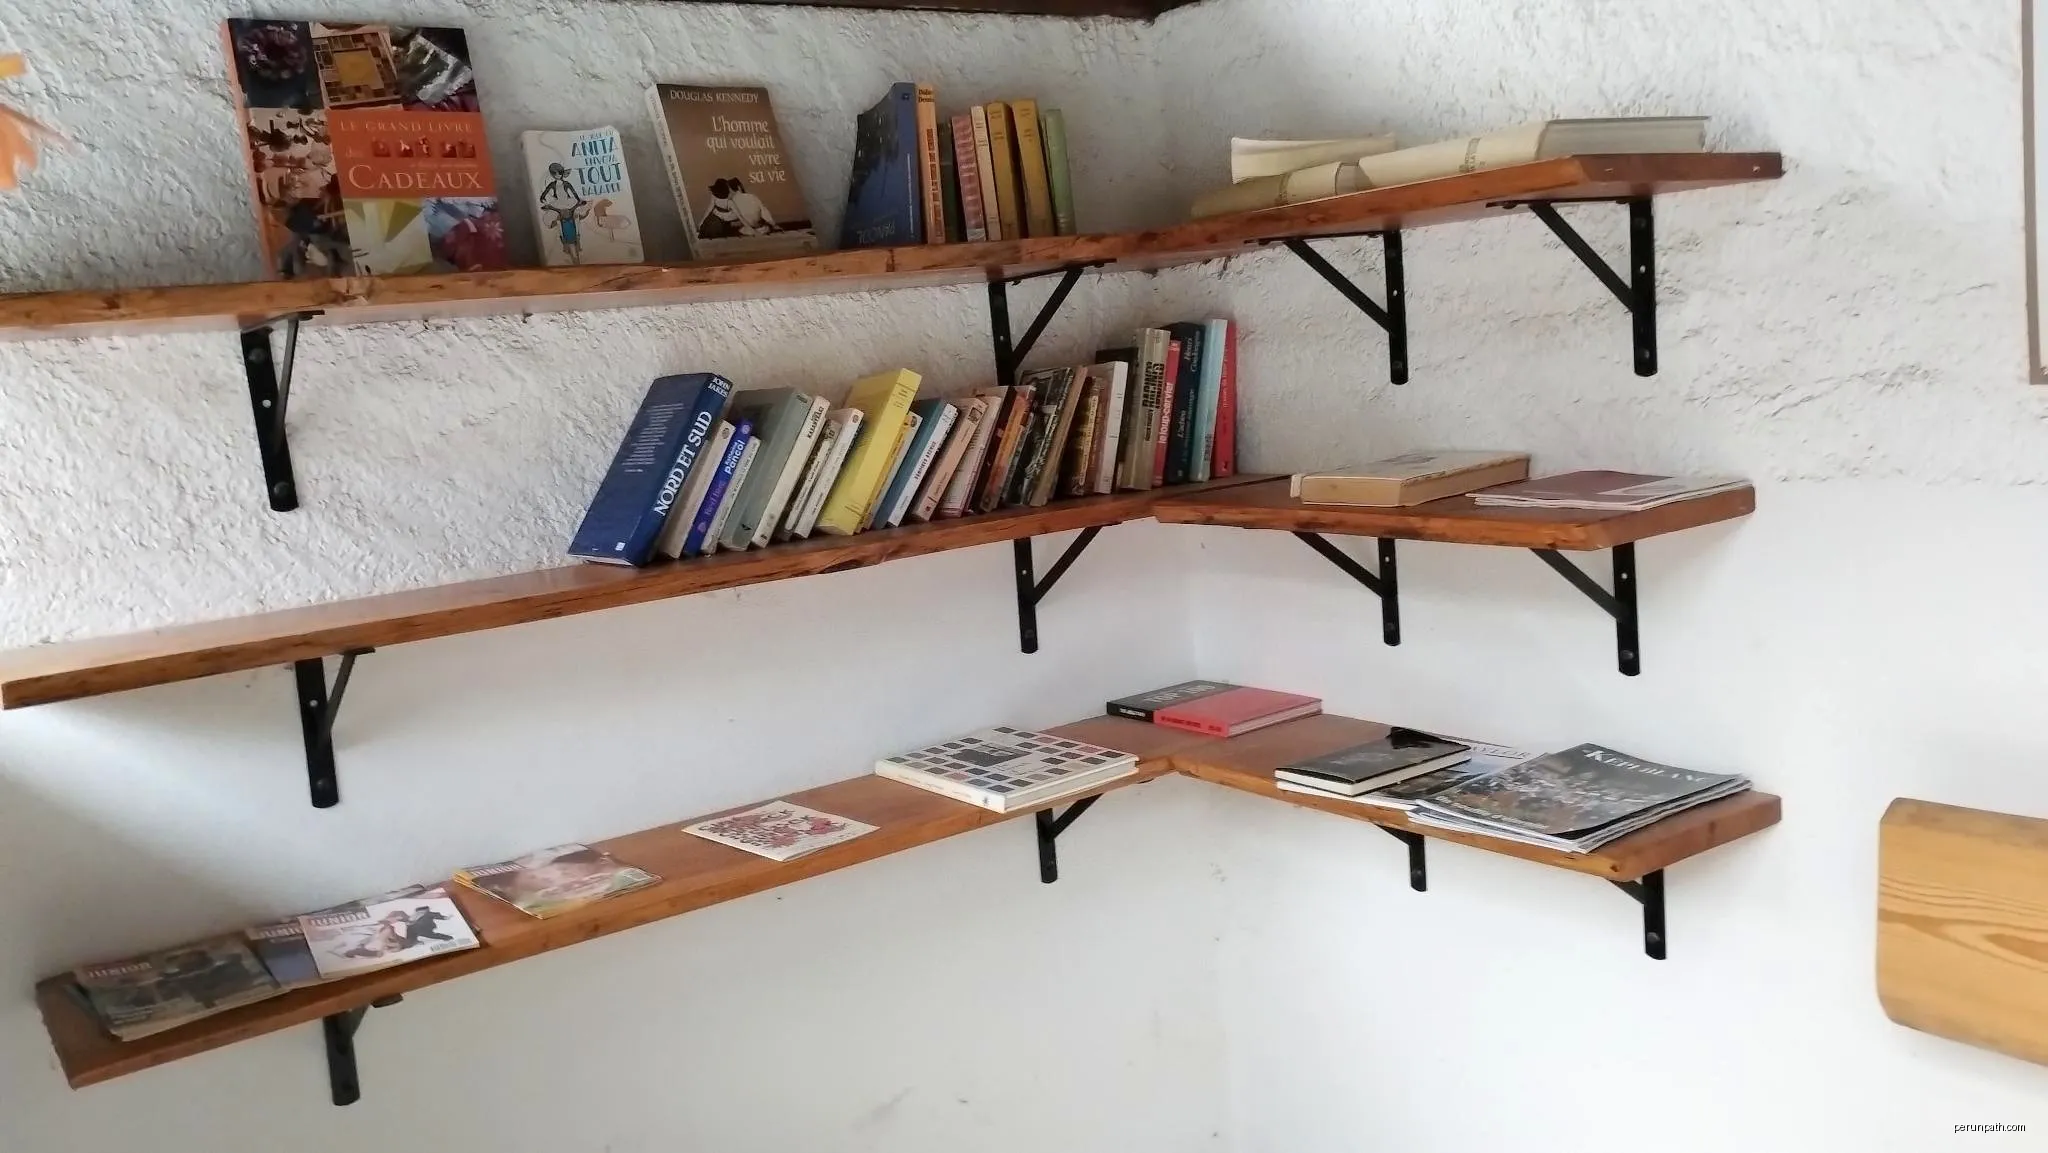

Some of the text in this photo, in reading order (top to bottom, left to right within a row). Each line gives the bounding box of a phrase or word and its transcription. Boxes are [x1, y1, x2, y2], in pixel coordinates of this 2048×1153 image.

[670, 90, 758, 104] DOUGLAS KENNEDY
[340, 121, 473, 132] LE GRAND LIVRE
[712, 115, 769, 132] L'homme
[572, 136, 620, 158] ANITA
[706, 134, 775, 153] qui voulait
[749, 154, 780, 166] vivre
[574, 163, 622, 184] TOUT
[749, 166, 786, 184] sa vie
[708, 383, 729, 398] JAKES
[712, 377, 731, 391] JOHN
[654, 411, 713, 516] NORD ET SUD
[724, 439, 746, 475] Pancol
[473, 864, 522, 878] JUNIOR
[308, 910, 370, 927] JUNIOR
[88, 962, 153, 978] JUNIOR
